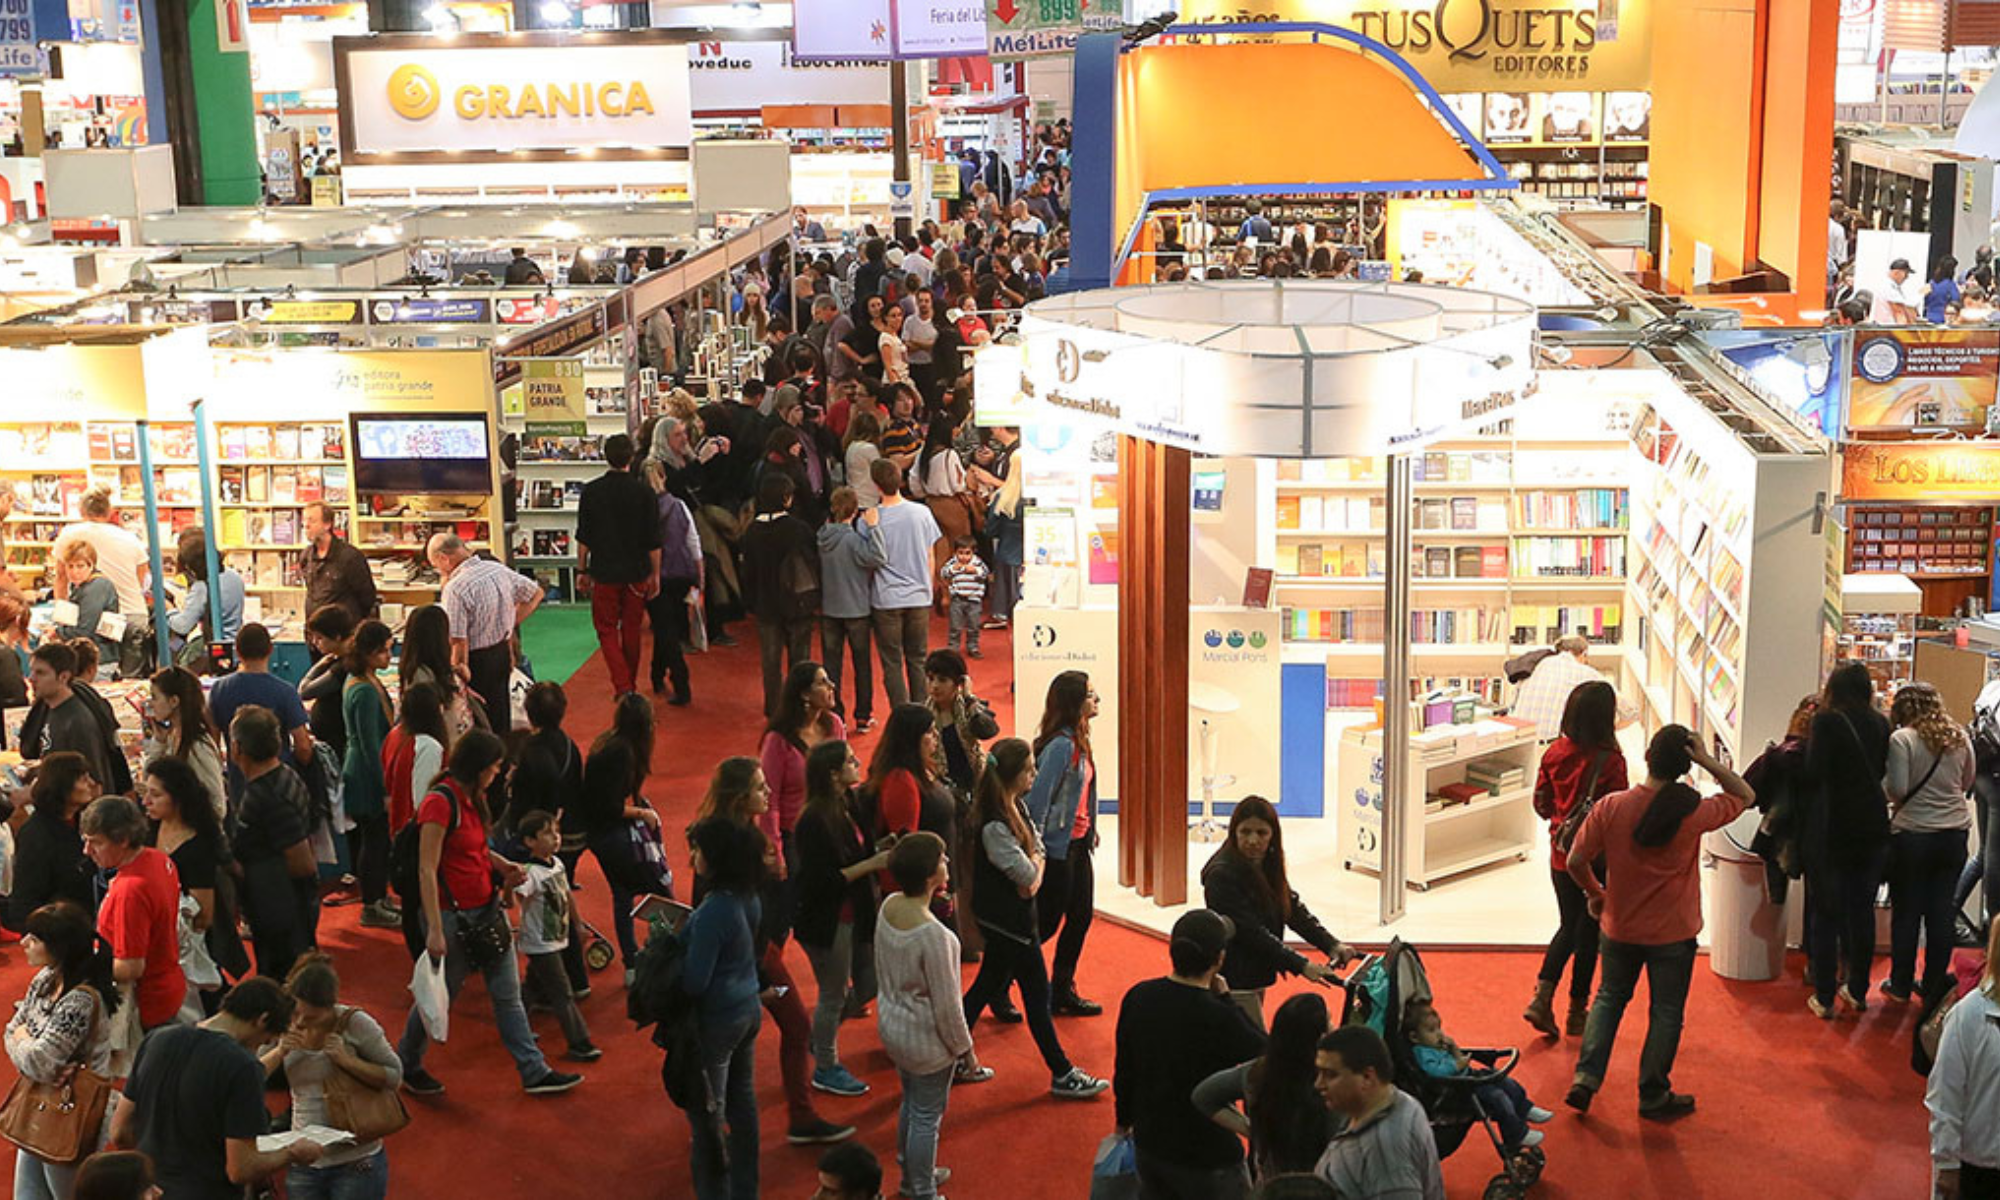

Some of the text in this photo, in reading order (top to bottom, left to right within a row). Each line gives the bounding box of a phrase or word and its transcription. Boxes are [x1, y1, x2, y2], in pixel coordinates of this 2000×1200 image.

[930, 8, 953, 23] Feria
[958, 7, 973, 22] del
[1039, 0, 1076, 22] 899
[0, 18, 31, 40] 799
[1083, 15, 1120, 28] etLife
[993, 31, 1077, 53] MetLife
[0, 47, 32, 66] ife
[1494, 55, 1588, 73] EDITORES
[454, 80, 654, 120] GRANICA
[555, 361, 581, 377] 830
[397, 380, 433, 392] grande
[529, 383, 564, 394] PATRIA
[530, 396, 567, 407] GRANDE
[1203, 650, 1240, 662] Marcial
